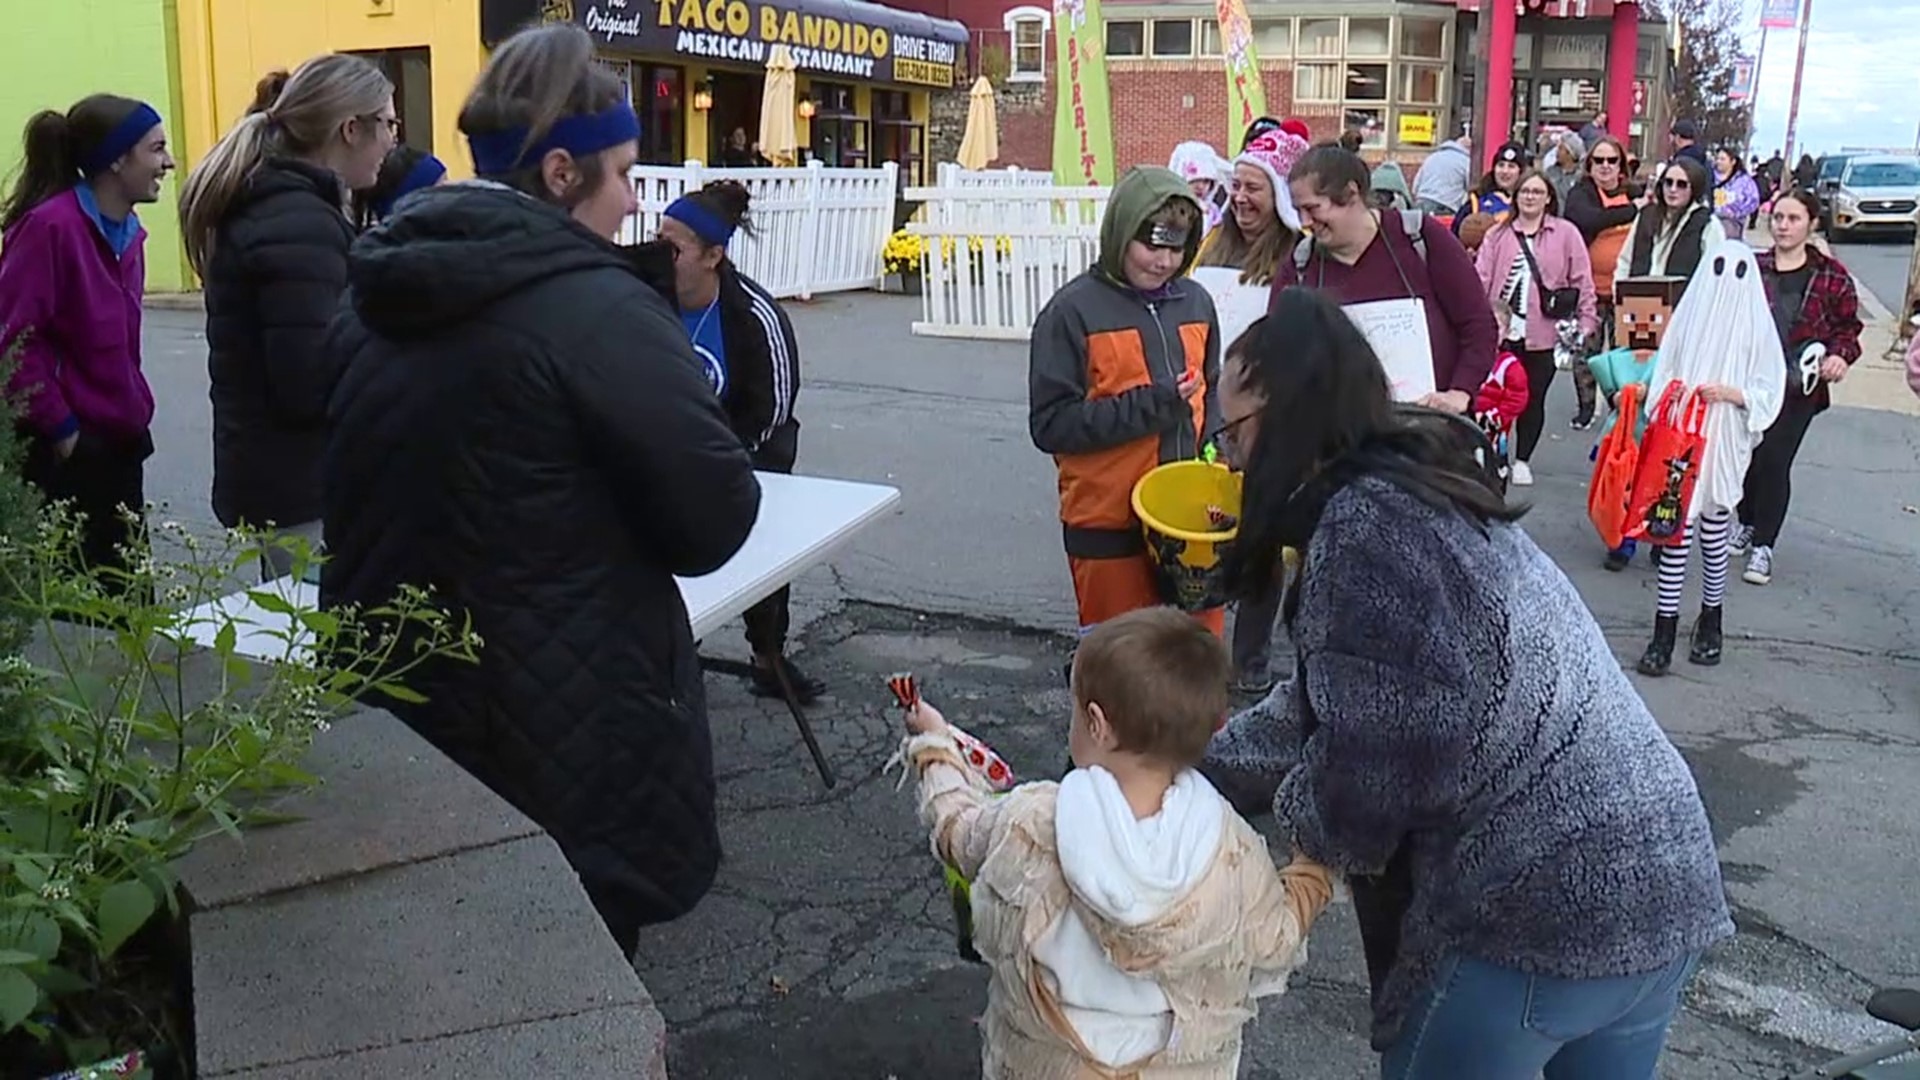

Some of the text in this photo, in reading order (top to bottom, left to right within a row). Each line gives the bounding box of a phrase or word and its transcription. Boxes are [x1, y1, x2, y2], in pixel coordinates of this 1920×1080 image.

[586, 6, 641, 42] Original
[655, 0, 889, 59] TACO BANDIDO
[676, 30, 874, 77] MEXICAN STAURANT
[893, 33, 955, 64] DRIVE THRU
